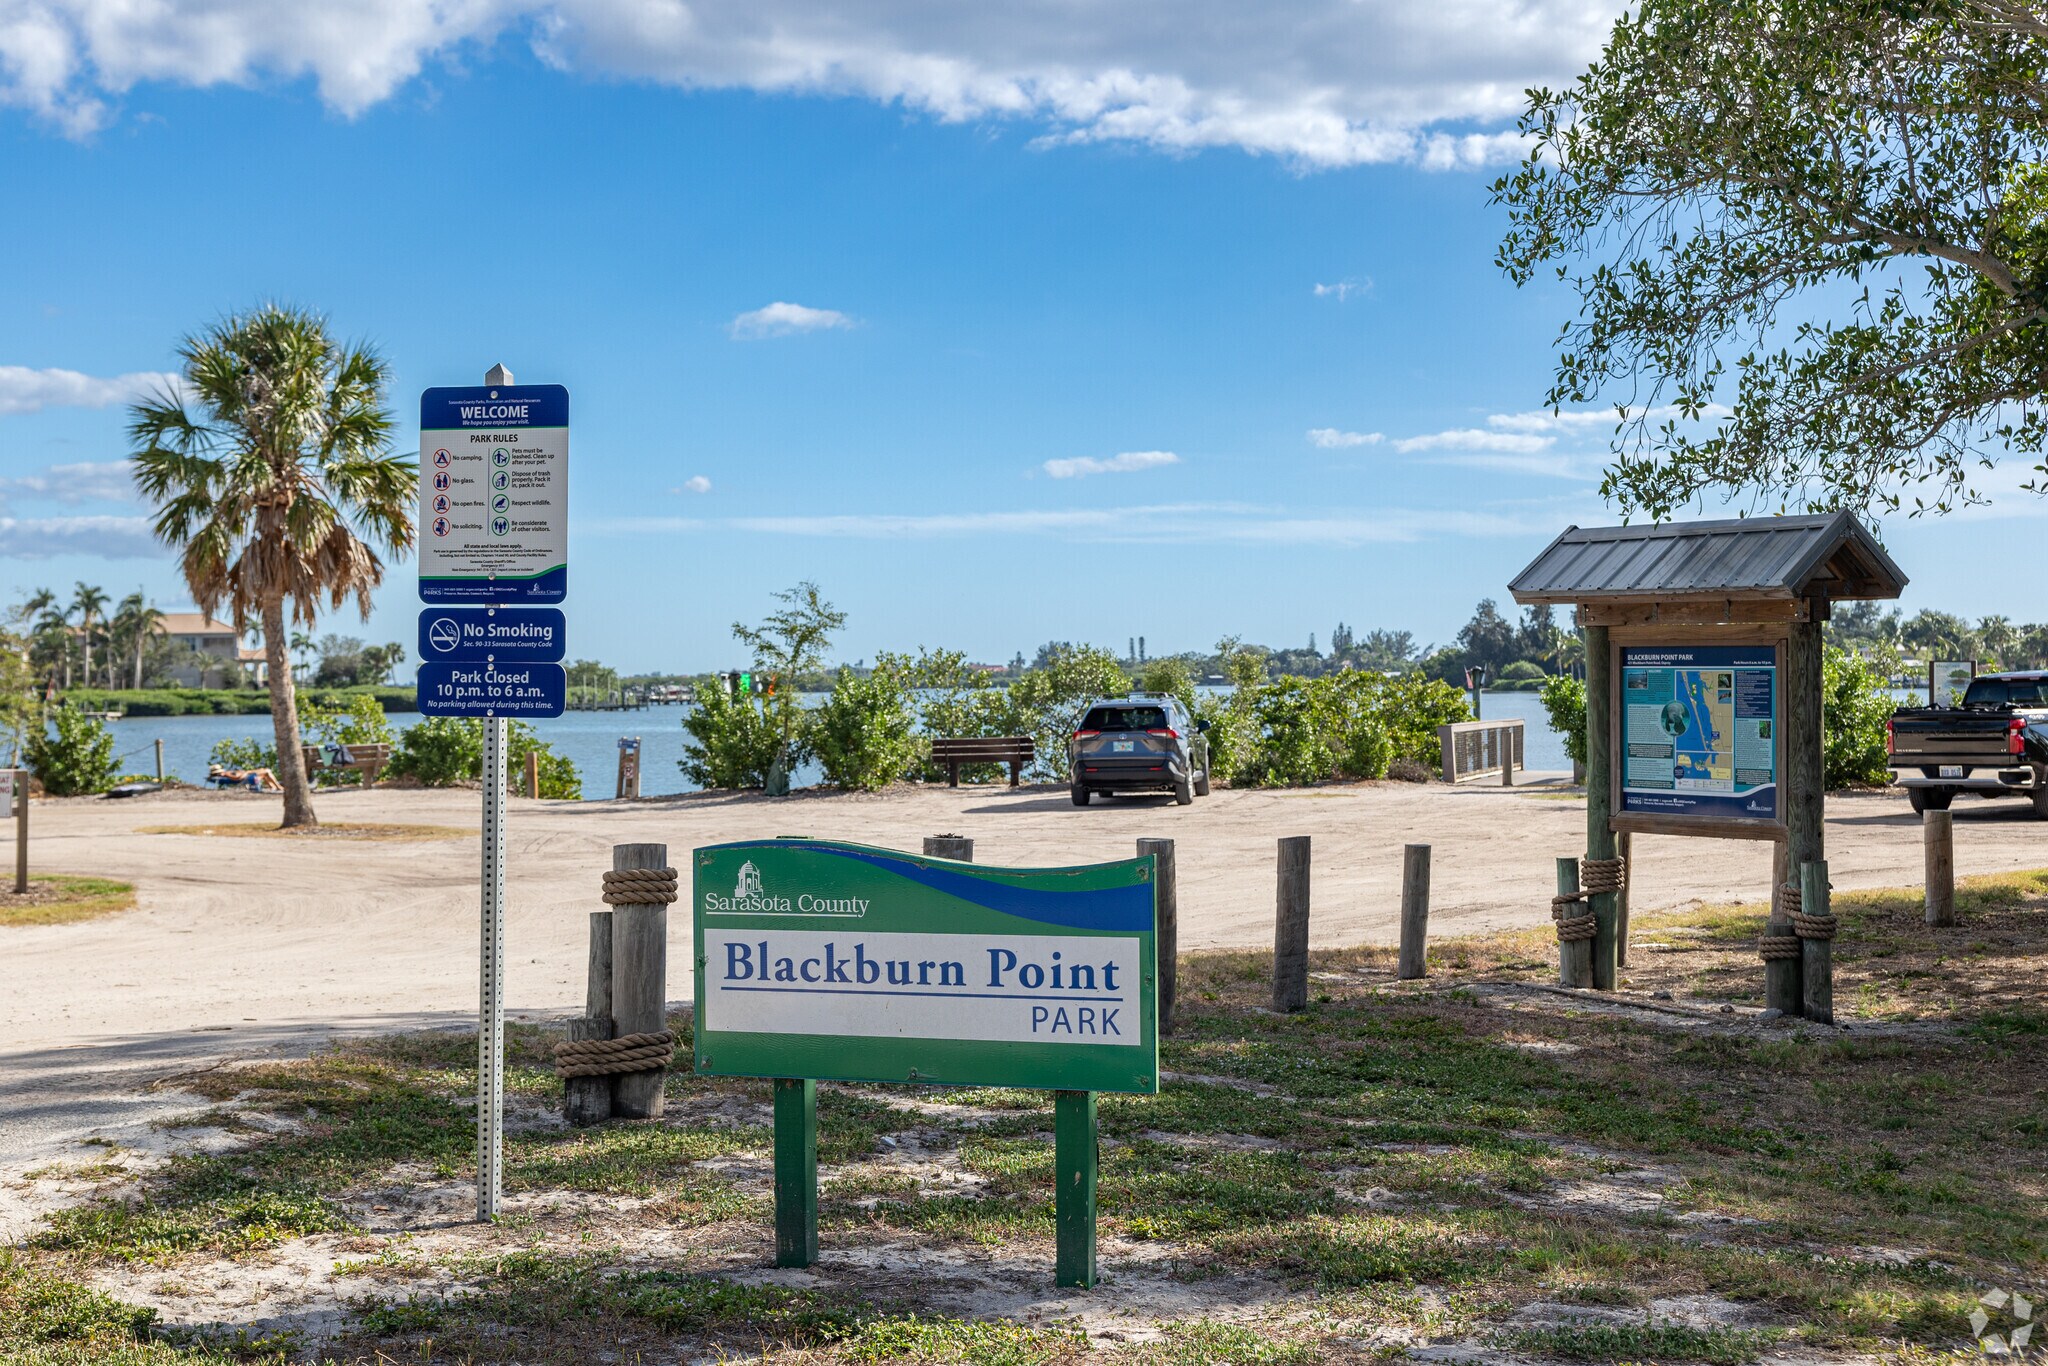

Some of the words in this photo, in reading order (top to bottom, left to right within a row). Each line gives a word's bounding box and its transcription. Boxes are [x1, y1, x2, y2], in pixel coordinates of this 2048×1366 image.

[460, 406, 528, 418] WELCOME
[494, 434, 518, 442] RULES
[464, 624, 484, 637] No
[488, 623, 552, 640] Smoking
[452, 671, 481, 683] Park
[485, 671, 529, 683] Closed
[437, 685, 452, 696] 10
[456, 686, 484, 699] p.m.
[488, 686, 501, 696] to
[504, 685, 513, 696] 6
[516, 687, 544, 697] a.m.
[439, 700, 466, 709] parking
[496, 701, 520, 710] during
[705, 894, 792, 912] Sarasota
[798, 895, 870, 918] County
[724, 941, 966, 987] Blackburn
[986, 948, 1120, 991] Point
[1032, 1006, 1121, 1035] PARK
